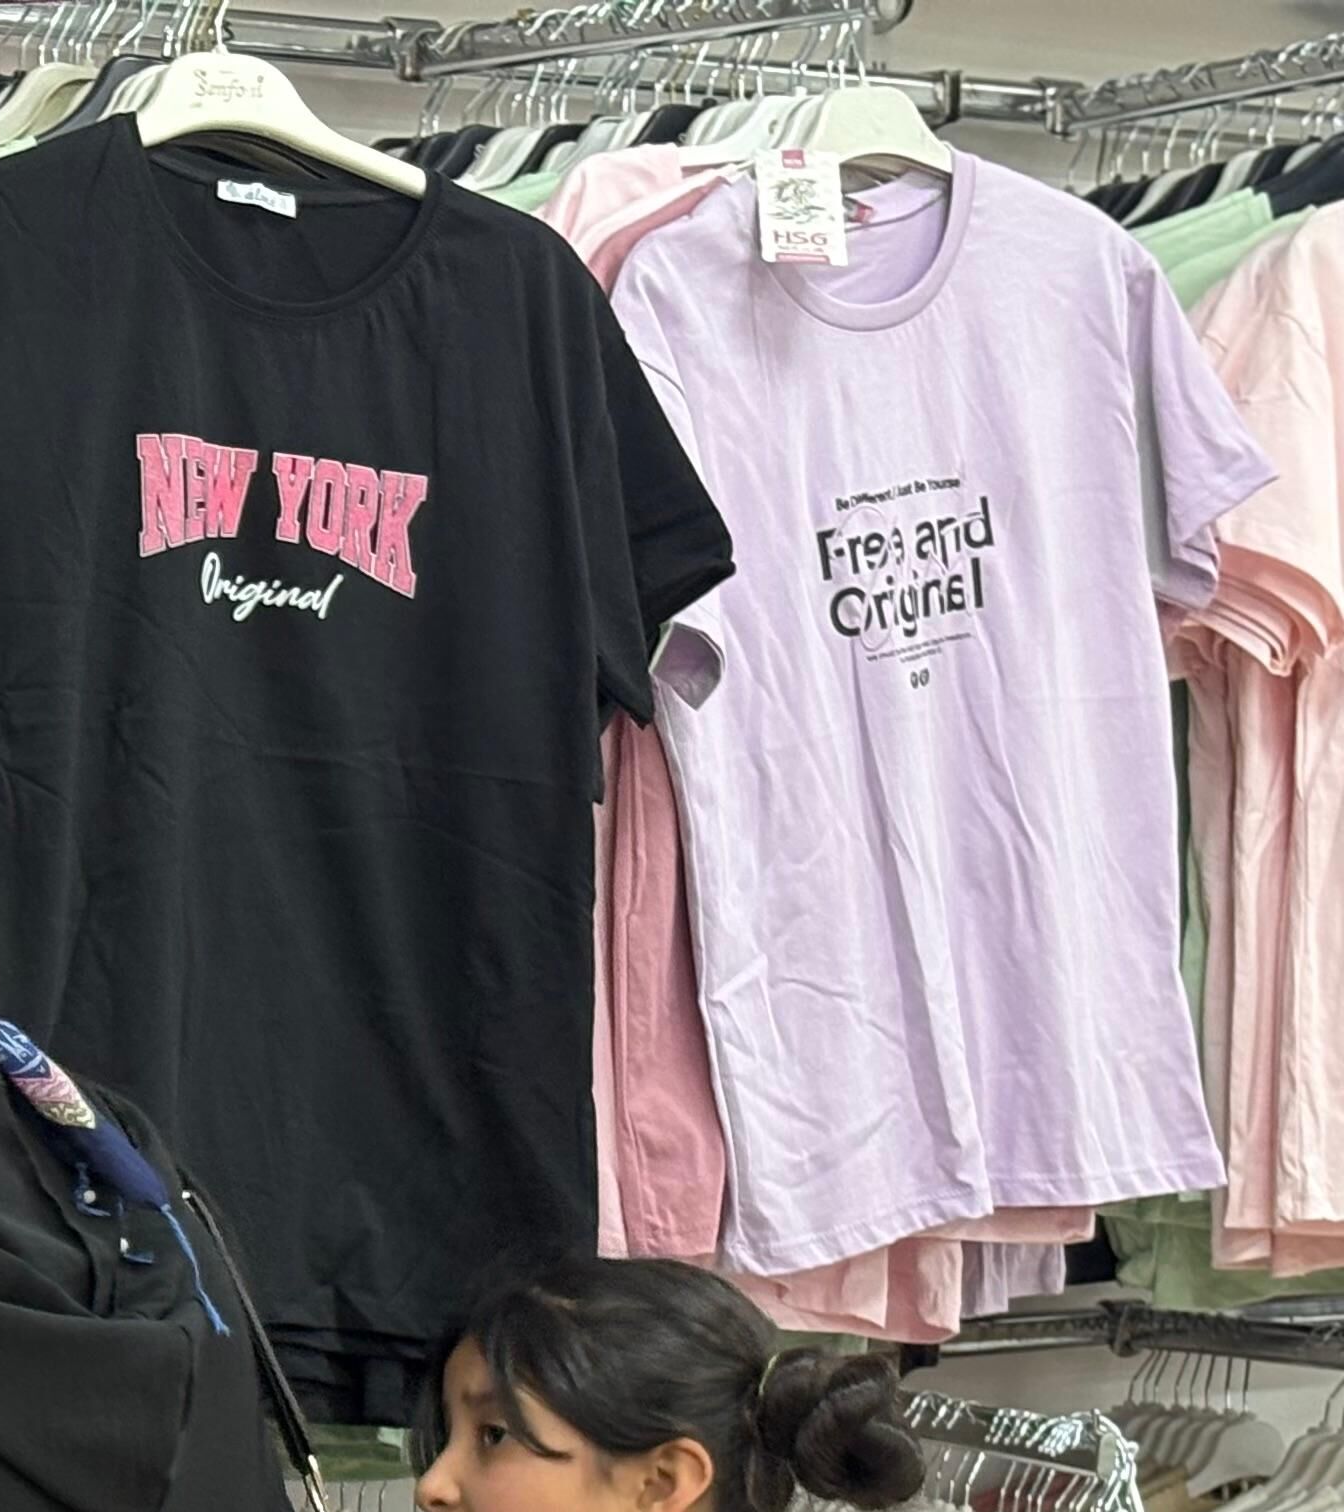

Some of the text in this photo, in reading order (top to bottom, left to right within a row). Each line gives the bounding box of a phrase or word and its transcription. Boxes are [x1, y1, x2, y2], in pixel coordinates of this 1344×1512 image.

[773, 230, 827, 246] HSG
[136, 434, 429, 599] NEW YORK
[915, 496, 994, 568] and
[200, 552, 344, 622] Original
[830, 557, 984, 637] Original
